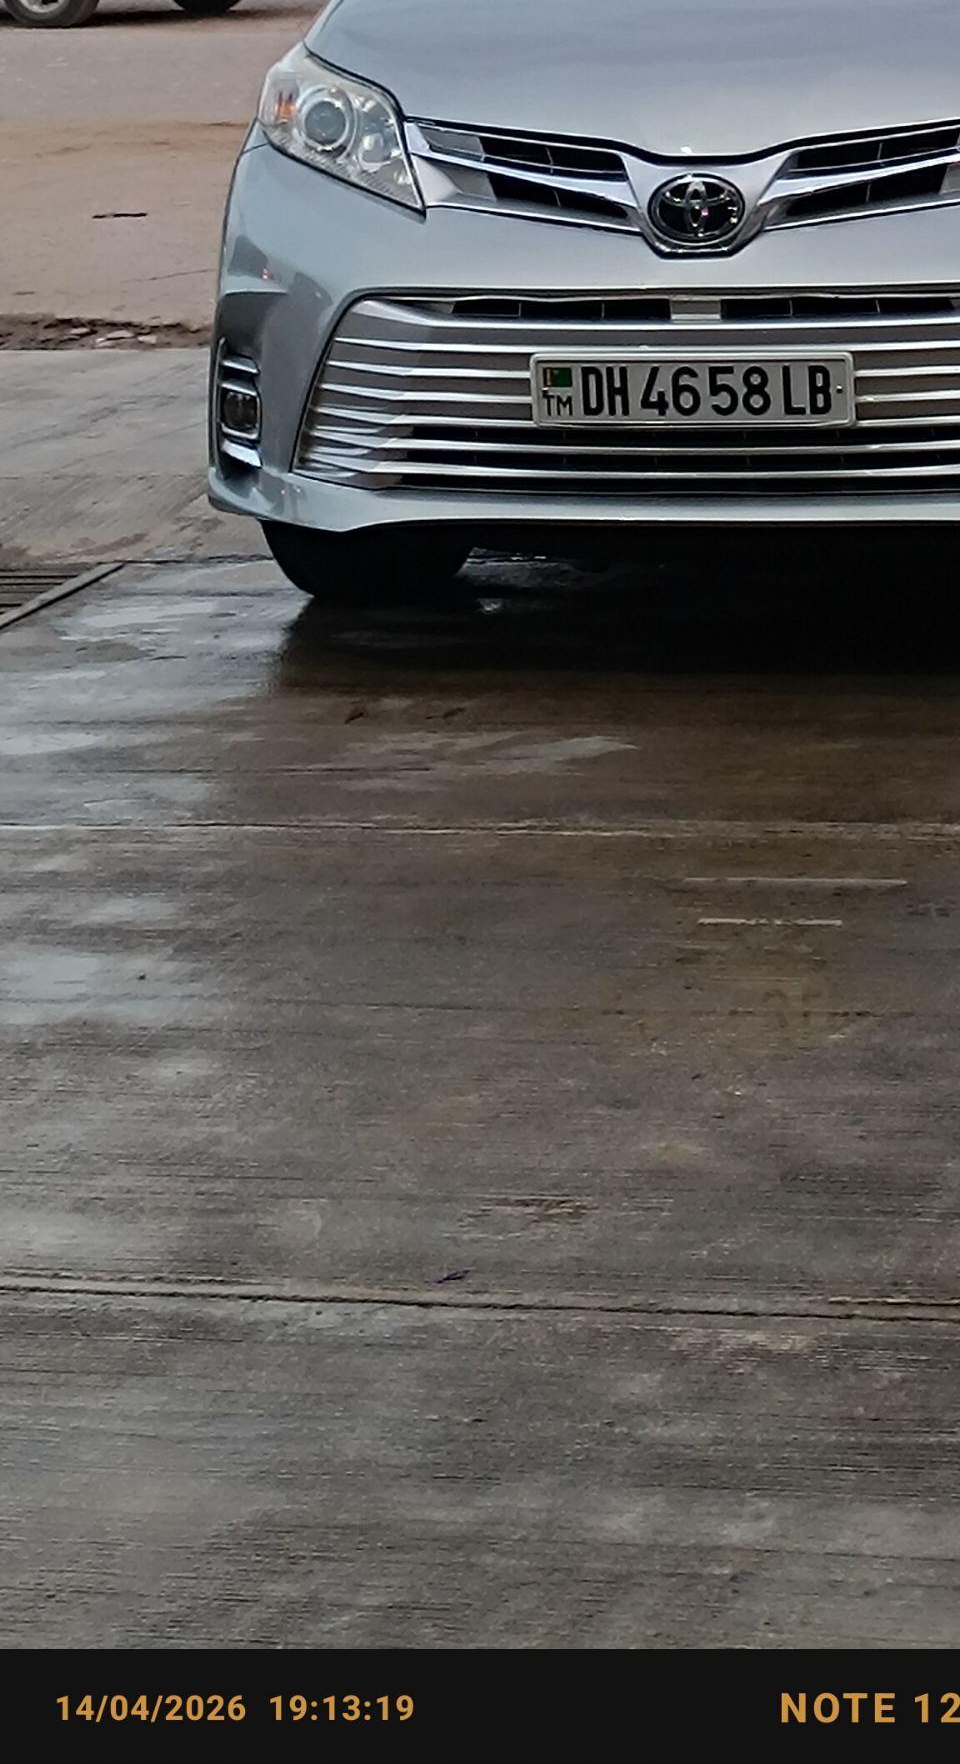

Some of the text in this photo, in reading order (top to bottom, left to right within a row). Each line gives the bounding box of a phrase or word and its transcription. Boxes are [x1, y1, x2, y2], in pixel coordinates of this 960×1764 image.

[542, 394, 573, 416] TM
[580, 364, 832, 416] DH 4658 LB
